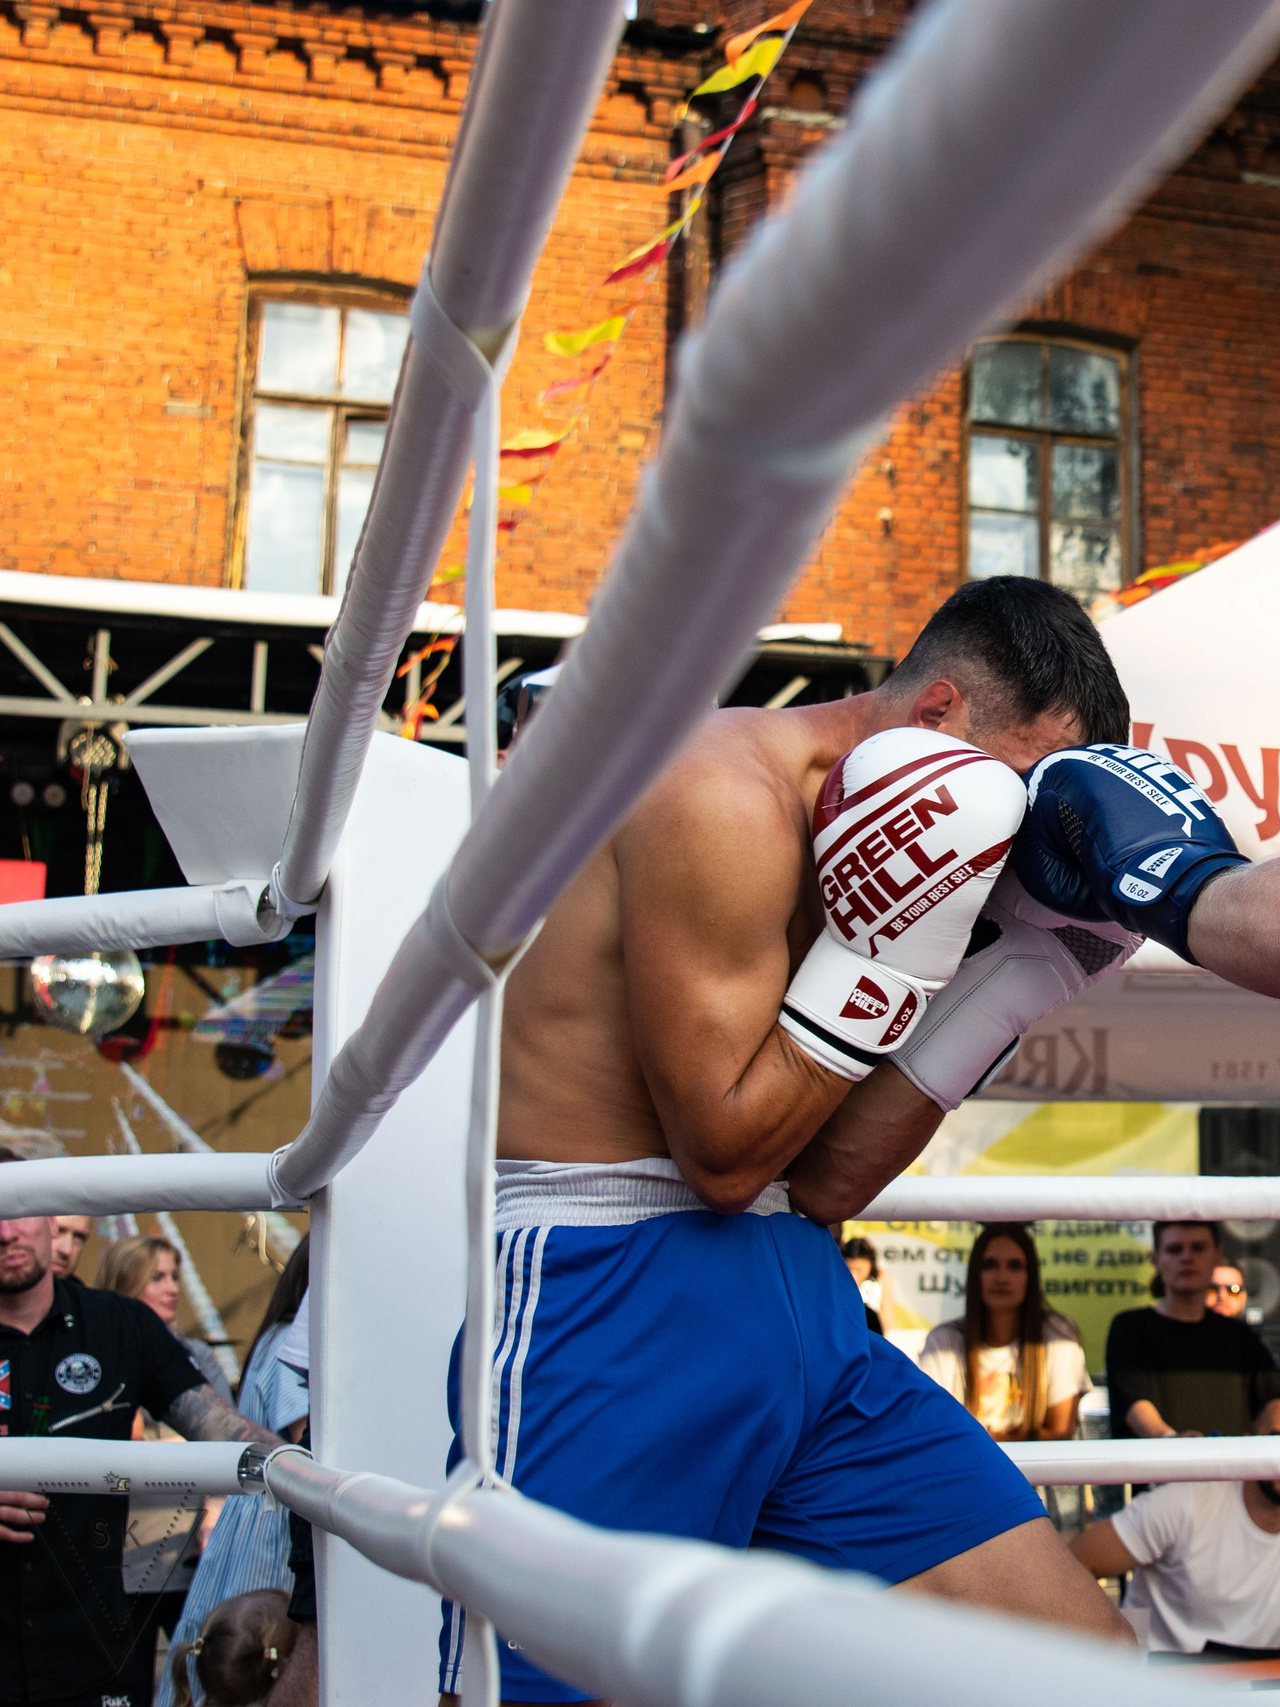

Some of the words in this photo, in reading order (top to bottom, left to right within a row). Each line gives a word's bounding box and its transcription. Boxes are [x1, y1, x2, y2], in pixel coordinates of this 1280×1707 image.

[1087, 754, 1101, 762] BE
[1100, 759, 1126, 775] YOUR
[1124, 770, 1149, 790] BEST
[1147, 788, 1171, 806] SELF
[821, 784, 959, 909] GREEN
[830, 841, 959, 942] HILL
[890, 917, 908, 932] BE
[905, 900, 932, 921] YOUR
[927, 880, 954, 902] BEST
[950, 863, 975, 884] SELF
[849, 994, 879, 1017] HILL
[853, 988, 889, 1012] GREEN
